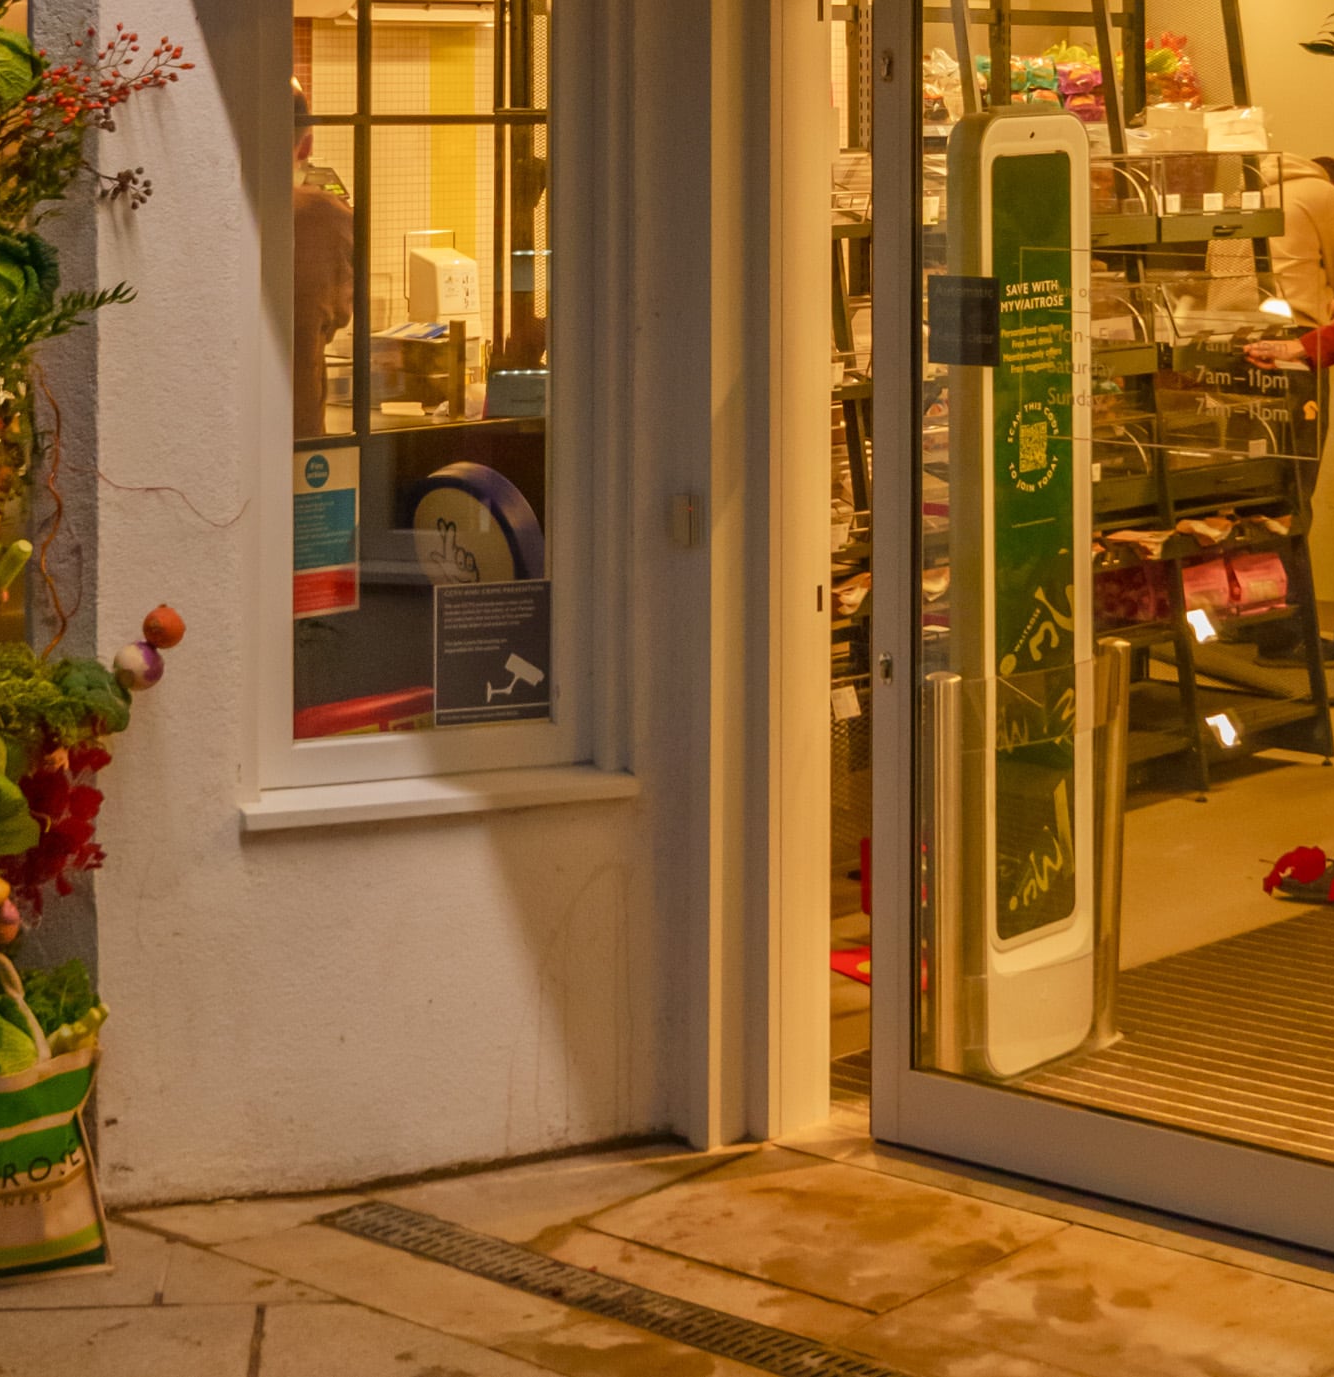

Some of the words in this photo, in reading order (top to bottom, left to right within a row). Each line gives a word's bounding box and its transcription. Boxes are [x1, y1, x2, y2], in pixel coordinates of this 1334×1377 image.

[1005, 282, 1029, 297] SAVE
[1031, 280, 1058, 294] WITH
[1000, 294, 1064, 313] MYWAITROSE
[1008, 411, 1021, 443] SCAN
[1024, 402, 1042, 413] THIS
[1044, 407, 1059, 435] CODE
[1009, 462, 1017, 479] TO
[1016, 479, 1036, 493] JOIN
[1037, 455, 1058, 488] TODAY
